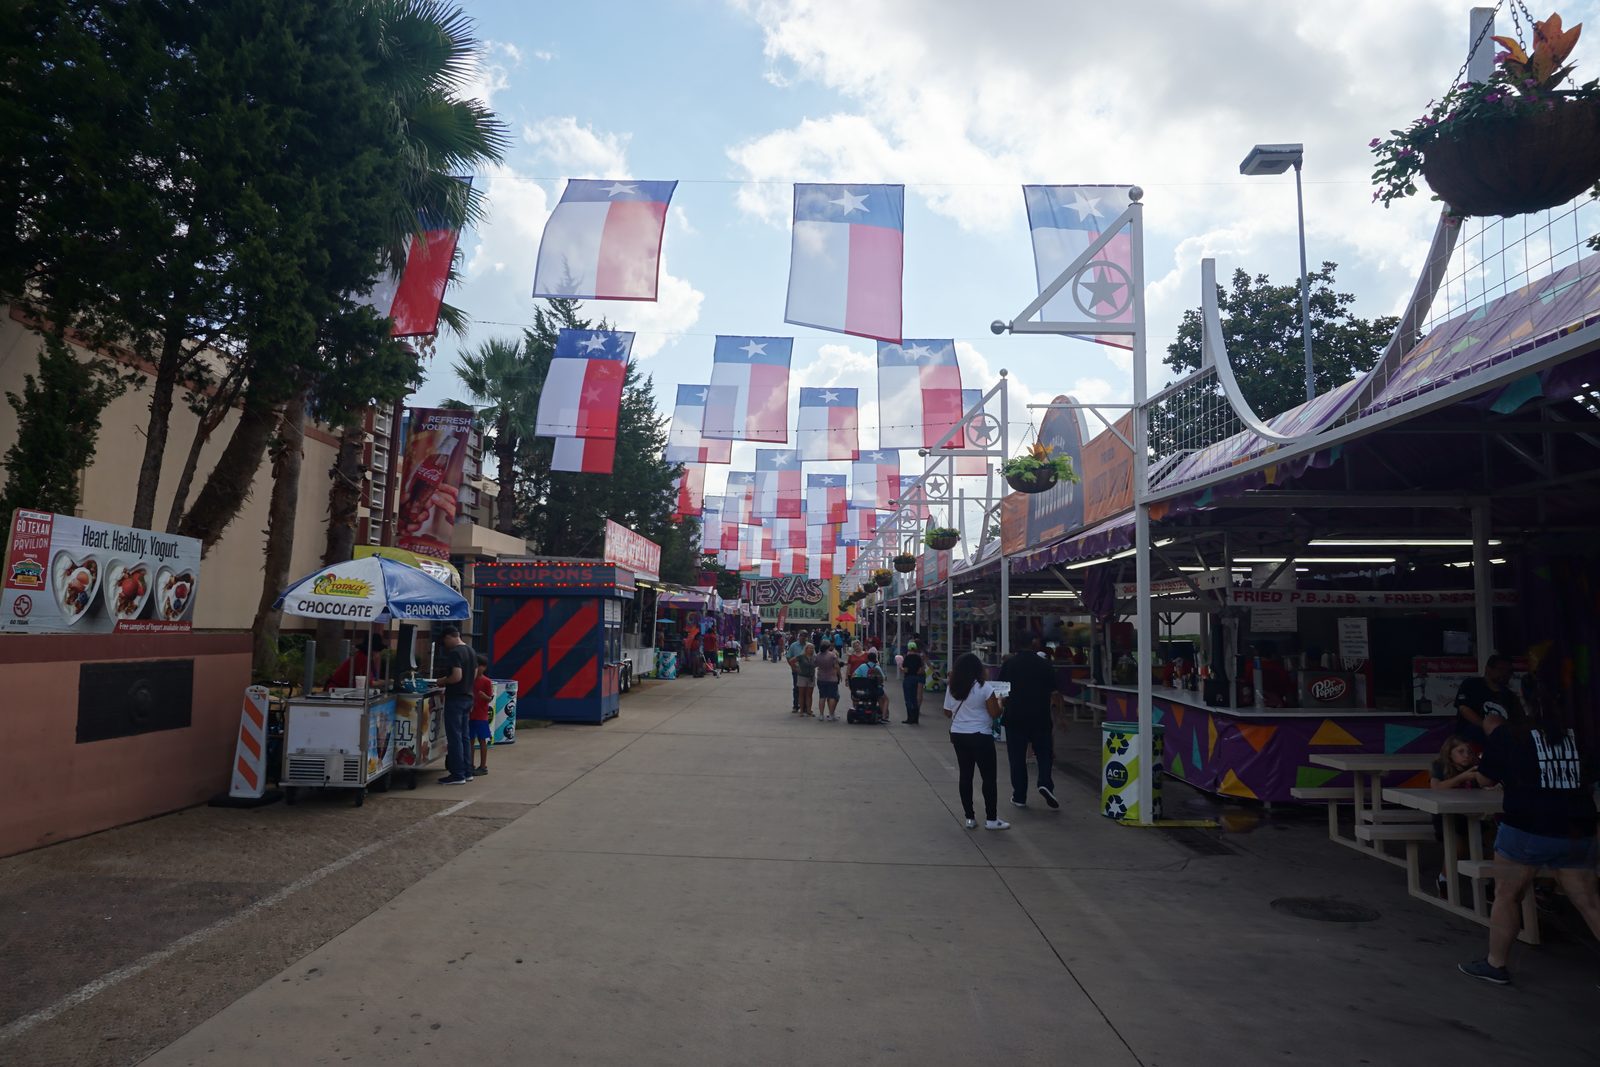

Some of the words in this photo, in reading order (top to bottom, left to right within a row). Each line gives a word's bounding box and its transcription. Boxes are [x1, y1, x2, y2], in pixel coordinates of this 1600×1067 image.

[428, 415, 471, 425] REFRESH
[421, 423, 448, 431] YOUR
[449, 425, 470, 433] FUN
[16, 519, 26, 533] GO
[28, 521, 50, 536] TEXAN
[13, 537, 49, 551] PAVILION
[82, 524, 110, 549] Heart.
[112, 529, 147, 560] Healthy.
[150, 535, 180, 562] Yogurt.
[497, 568, 593, 581] COUPONS
[331, 583, 366, 591] TOTALLY
[1233, 590, 1283, 603] FRIED
[1383, 593, 1434, 604] FRIED
[297, 600, 373, 617] CHOCOLATE
[405, 604, 451, 616] BANANAS
[119, 622, 129, 630] Free
[1324, 679, 1336, 689] Dr
[1313, 682, 1345, 700] Pepper
[1107, 769, 1125, 778] ACT
